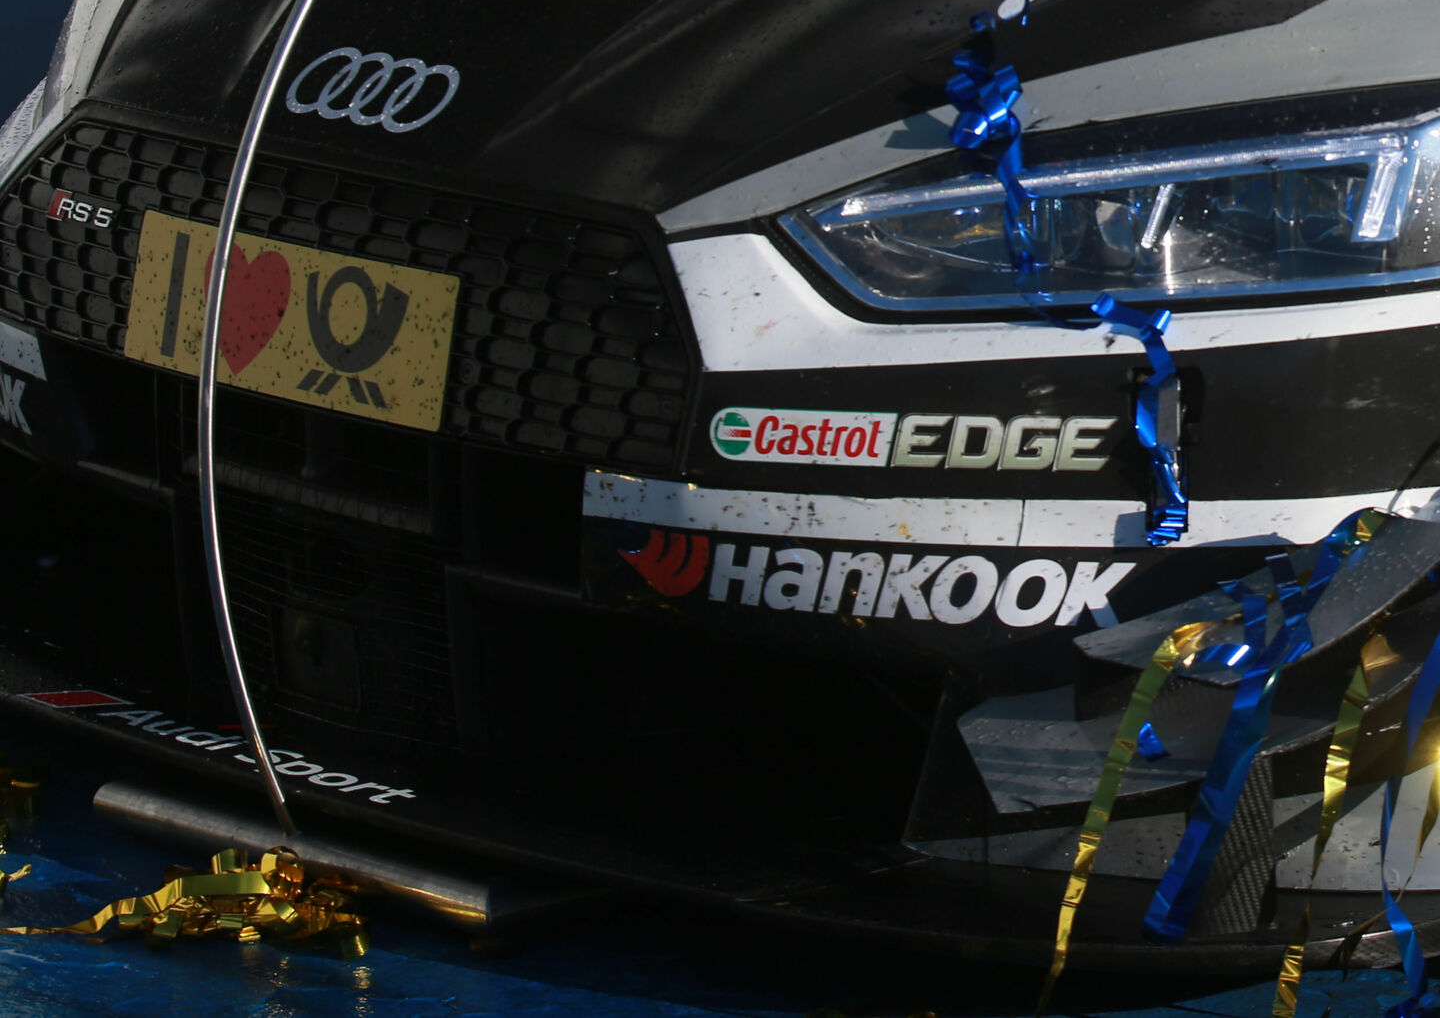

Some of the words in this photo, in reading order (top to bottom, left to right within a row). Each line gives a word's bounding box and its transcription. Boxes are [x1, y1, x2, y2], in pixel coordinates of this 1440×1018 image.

[755, 415, 881, 458] Castrol
[891, 413, 1120, 473] EDGE
[101, 708, 254, 752] Audi
[234, 748, 417, 805] Sport
